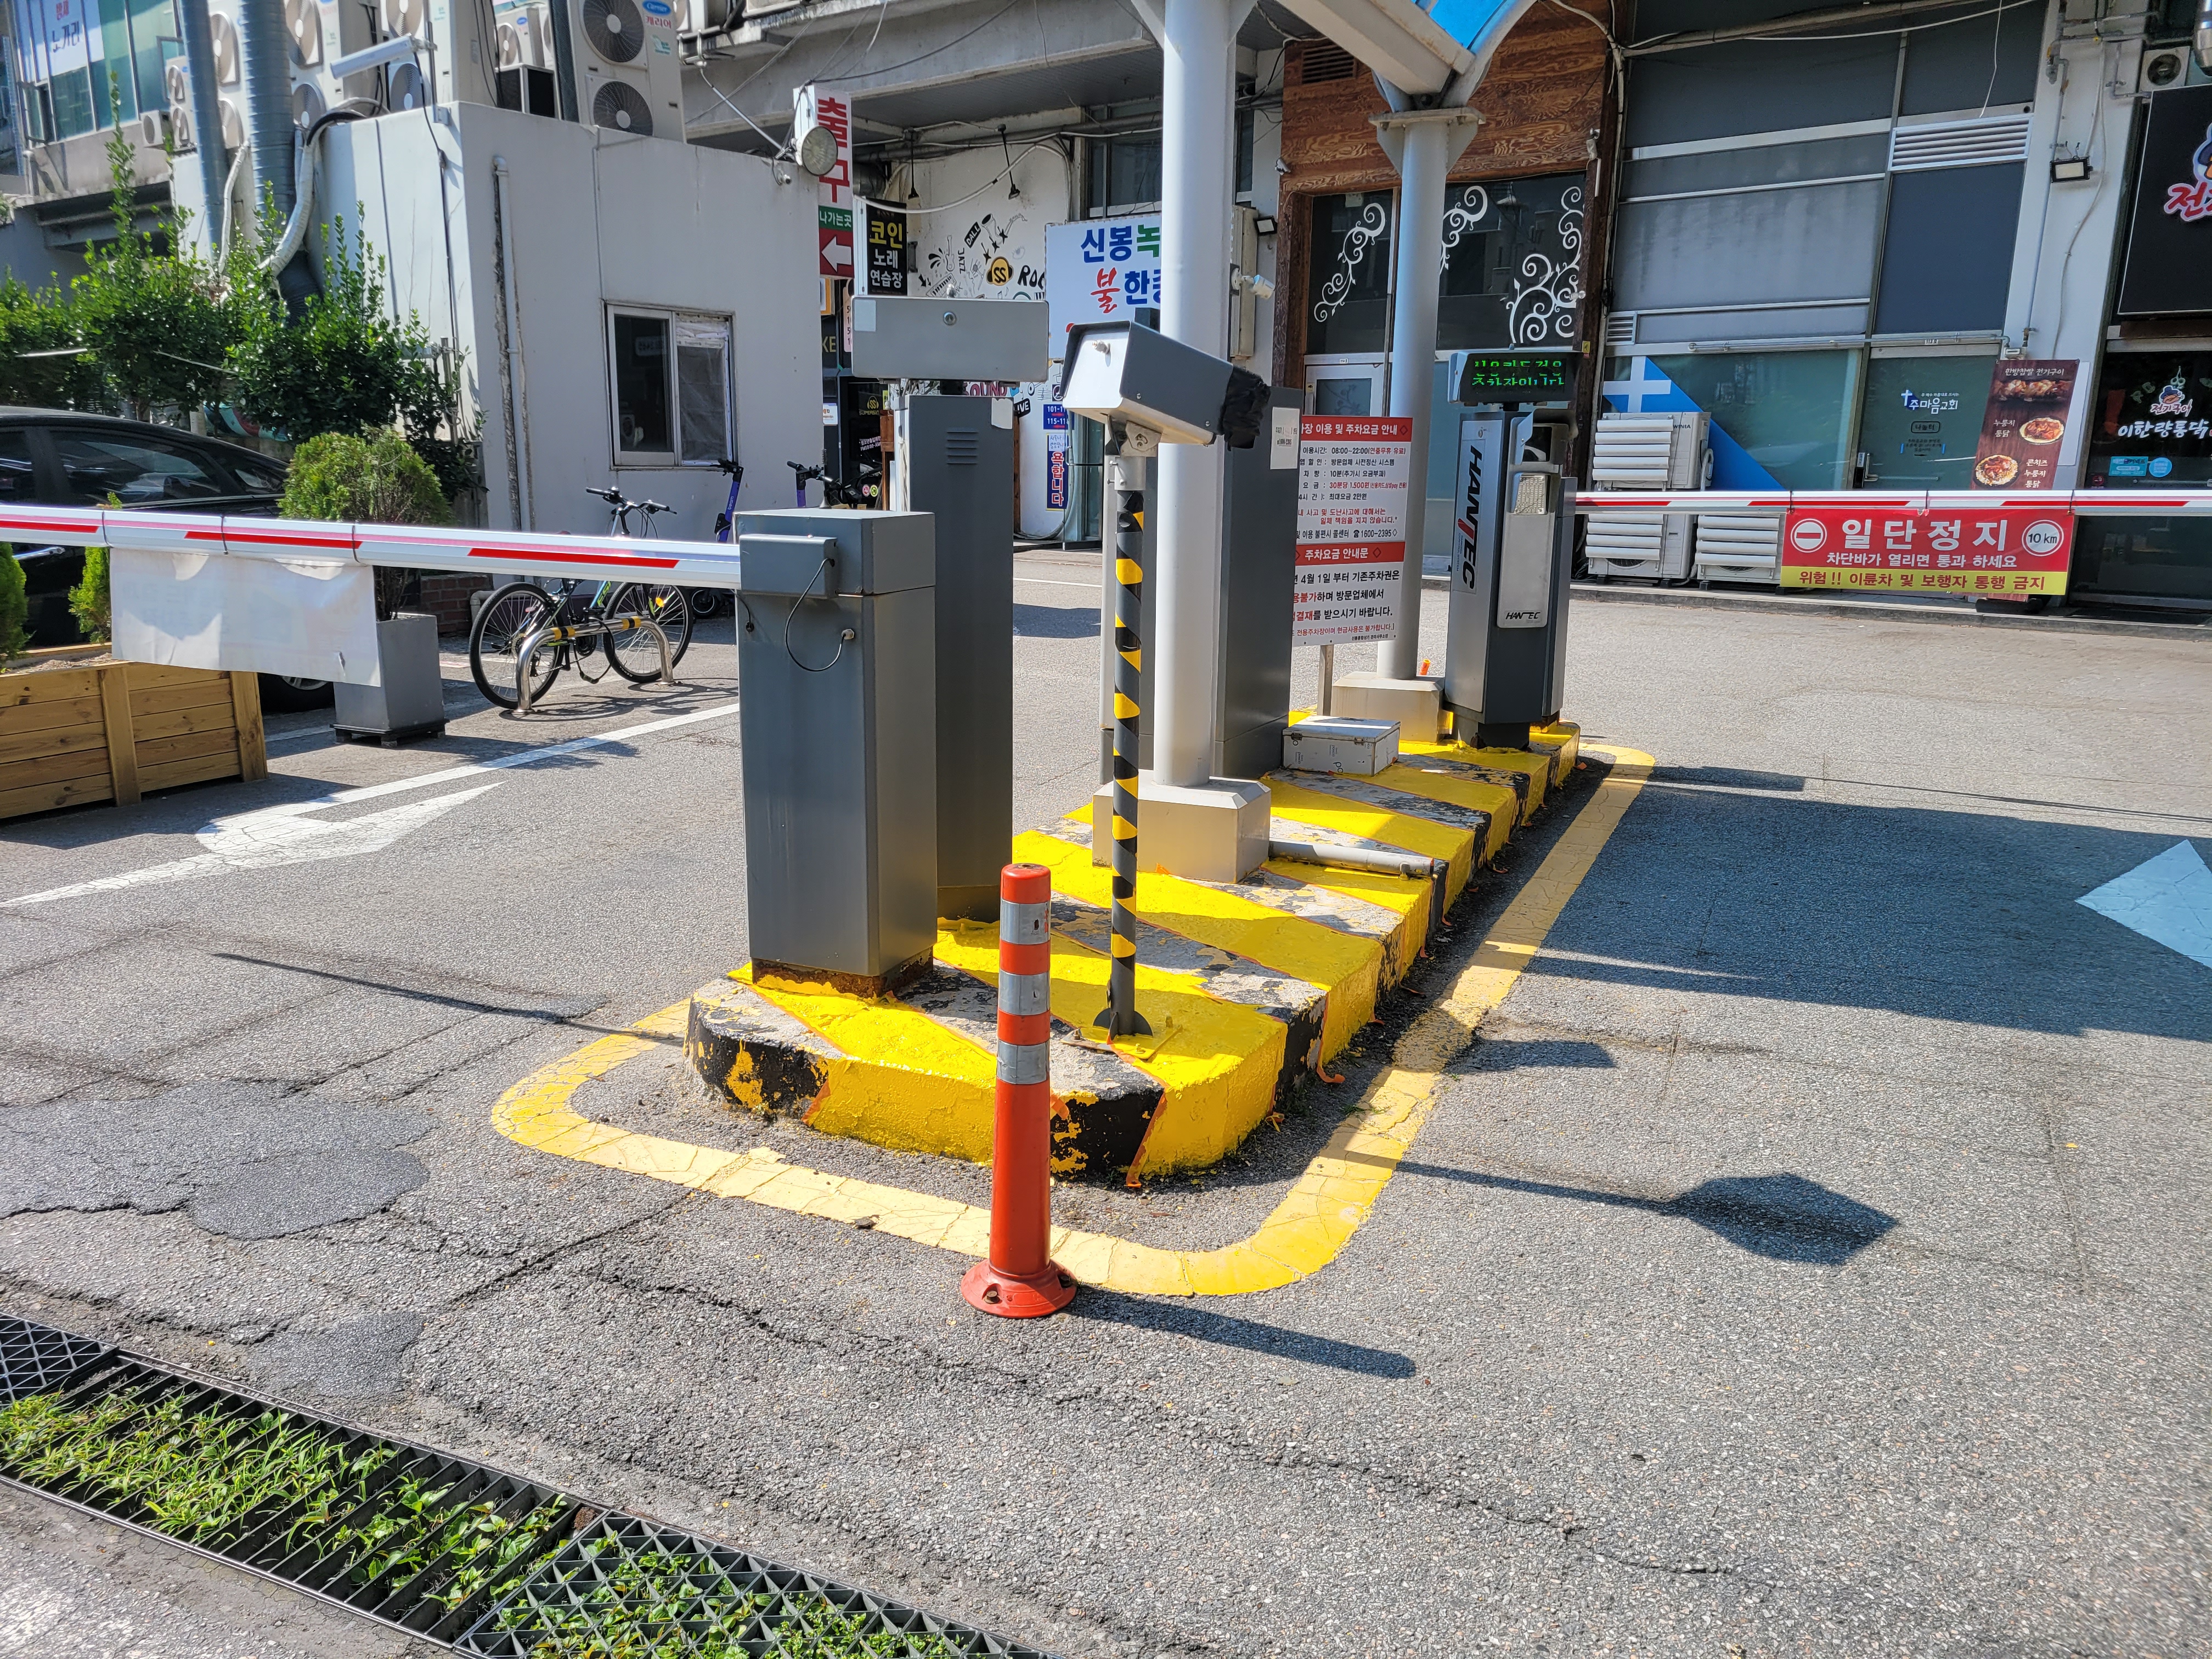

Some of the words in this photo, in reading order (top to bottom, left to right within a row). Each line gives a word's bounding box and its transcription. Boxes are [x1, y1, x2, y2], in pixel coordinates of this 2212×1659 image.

[2166, 182, 2212, 219] 전
[819, 211, 851, 228] 나가는곳
[870, 221, 902, 249] 코인
[873, 249, 898, 269] 노래
[870, 269, 902, 289] 연습장
[1909, 398, 1958, 414] 주마음교회
[2151, 399, 2193, 417] 전기구이
[1316, 423, 1333, 435] 이용
[1335, 424, 1343, 435] 및
[1346, 424, 1379, 436] 주차요금
[1381, 424, 1397, 436] 안내
[2025, 480, 2041, 488] 통닭
[1458, 445, 1482, 589] HANTEC
[1302, 531, 1313, 539] 이용
[1315, 530, 1331, 538] 불편시
[1333, 529, 1349, 538] 콜센터
[1361, 529, 1391, 538] 1600-2395
[2028, 533, 2039, 544] 10
[2040, 533, 2057, 544] km
[1305, 549, 1340, 561] 주차요금
[1342, 548, 1368, 559] 안내문
[1827, 552, 1881, 566] 차단바가
[1888, 554, 1929, 567] 열리면
[1936, 555, 1966, 568] 통과
[1973, 555, 2017, 568] 하세요
[1301, 574, 1314, 584] 4월
[1318, 573, 1330, 583] 1일
[1333, 572, 1348, 583] 부터
[1352, 570, 1400, 582] 기존주차권은
[1850, 572, 1893, 587] 이륜차
[1901, 574, 1914, 587] 및
[1921, 574, 1967, 588] 보행자
[1974, 575, 2006, 590] 통행
[2013, 575, 2045, 590] 금지
[1336, 589, 1384, 601] 방문업체에서
[1324, 608, 1356, 620] 받으시기
[1359, 606, 1392, 617] 바랍니다.
[1297, 627, 1335, 636] 전용주차장이며
[1338, 625, 1363, 634] 현금사용은
